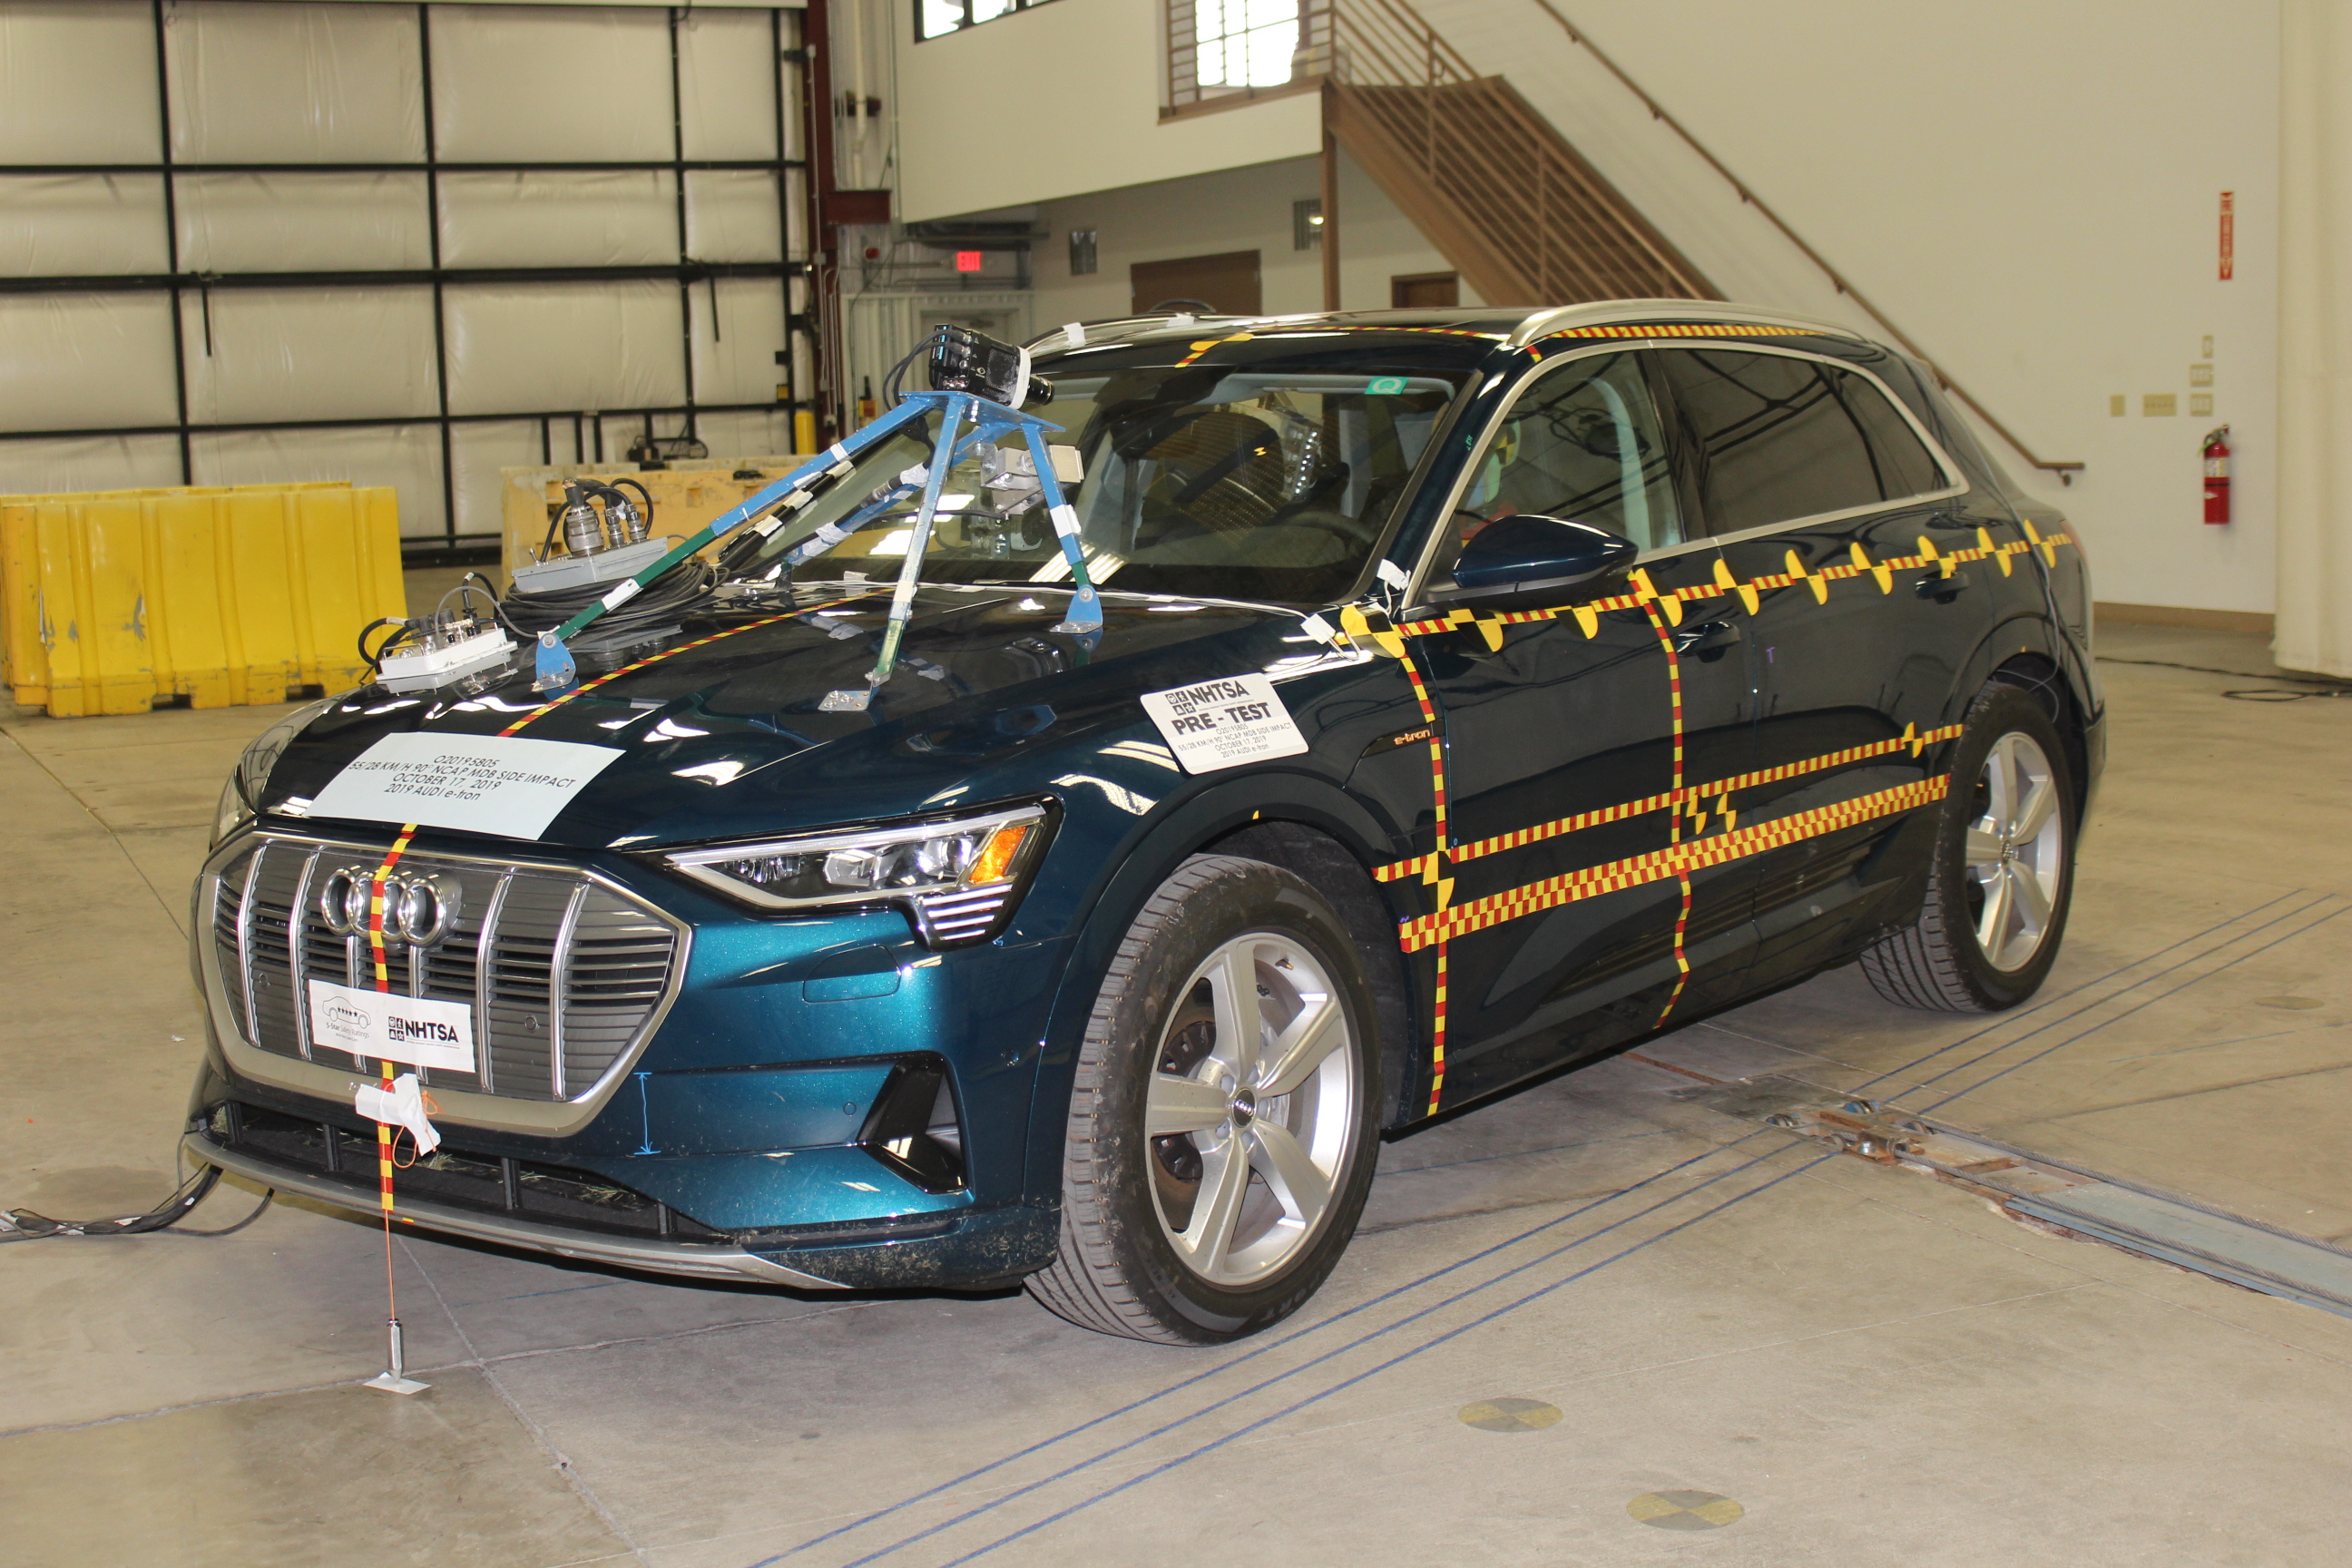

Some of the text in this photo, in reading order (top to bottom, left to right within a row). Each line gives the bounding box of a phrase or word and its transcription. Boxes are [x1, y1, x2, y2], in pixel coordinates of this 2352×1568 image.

[1186, 680, 1250, 705] NHTSA
[1171, 712, 1217, 736] PRE
[1224, 701, 1272, 723] TEST
[1179, 740, 1197, 751] 55/28
[1197, 738, 1214, 748] KM/H
[1224, 731, 1242, 742] NCAP
[1244, 729, 1257, 738] MDB
[1256, 725, 1270, 735] SIDE
[1269, 722, 1292, 732] IMPACT
[1214, 740, 1243, 751] OCTOBER
[1253, 735, 1268, 744] 2019
[1394, 729, 1431, 745] e-tron
[1220, 749, 1236, 759] 2019
[1237, 746, 1251, 755] AUDI
[348, 761, 382, 771] 55/28
[380, 761, 414, 772] KM/H
[431, 765, 469, 776] NCAP
[467, 768, 498, 779] MDB
[496, 770, 527, 781] SIDE
[524, 773, 577, 789] IMPACT
[393, 772, 447, 785] OCTOBER
[469, 779, 503, 789] 2019
[384, 783, 482, 800] 2019 AUDI e-tron
[351, 1028, 370, 1039] Ratings
[405, 1020, 460, 1043] NHTSA
